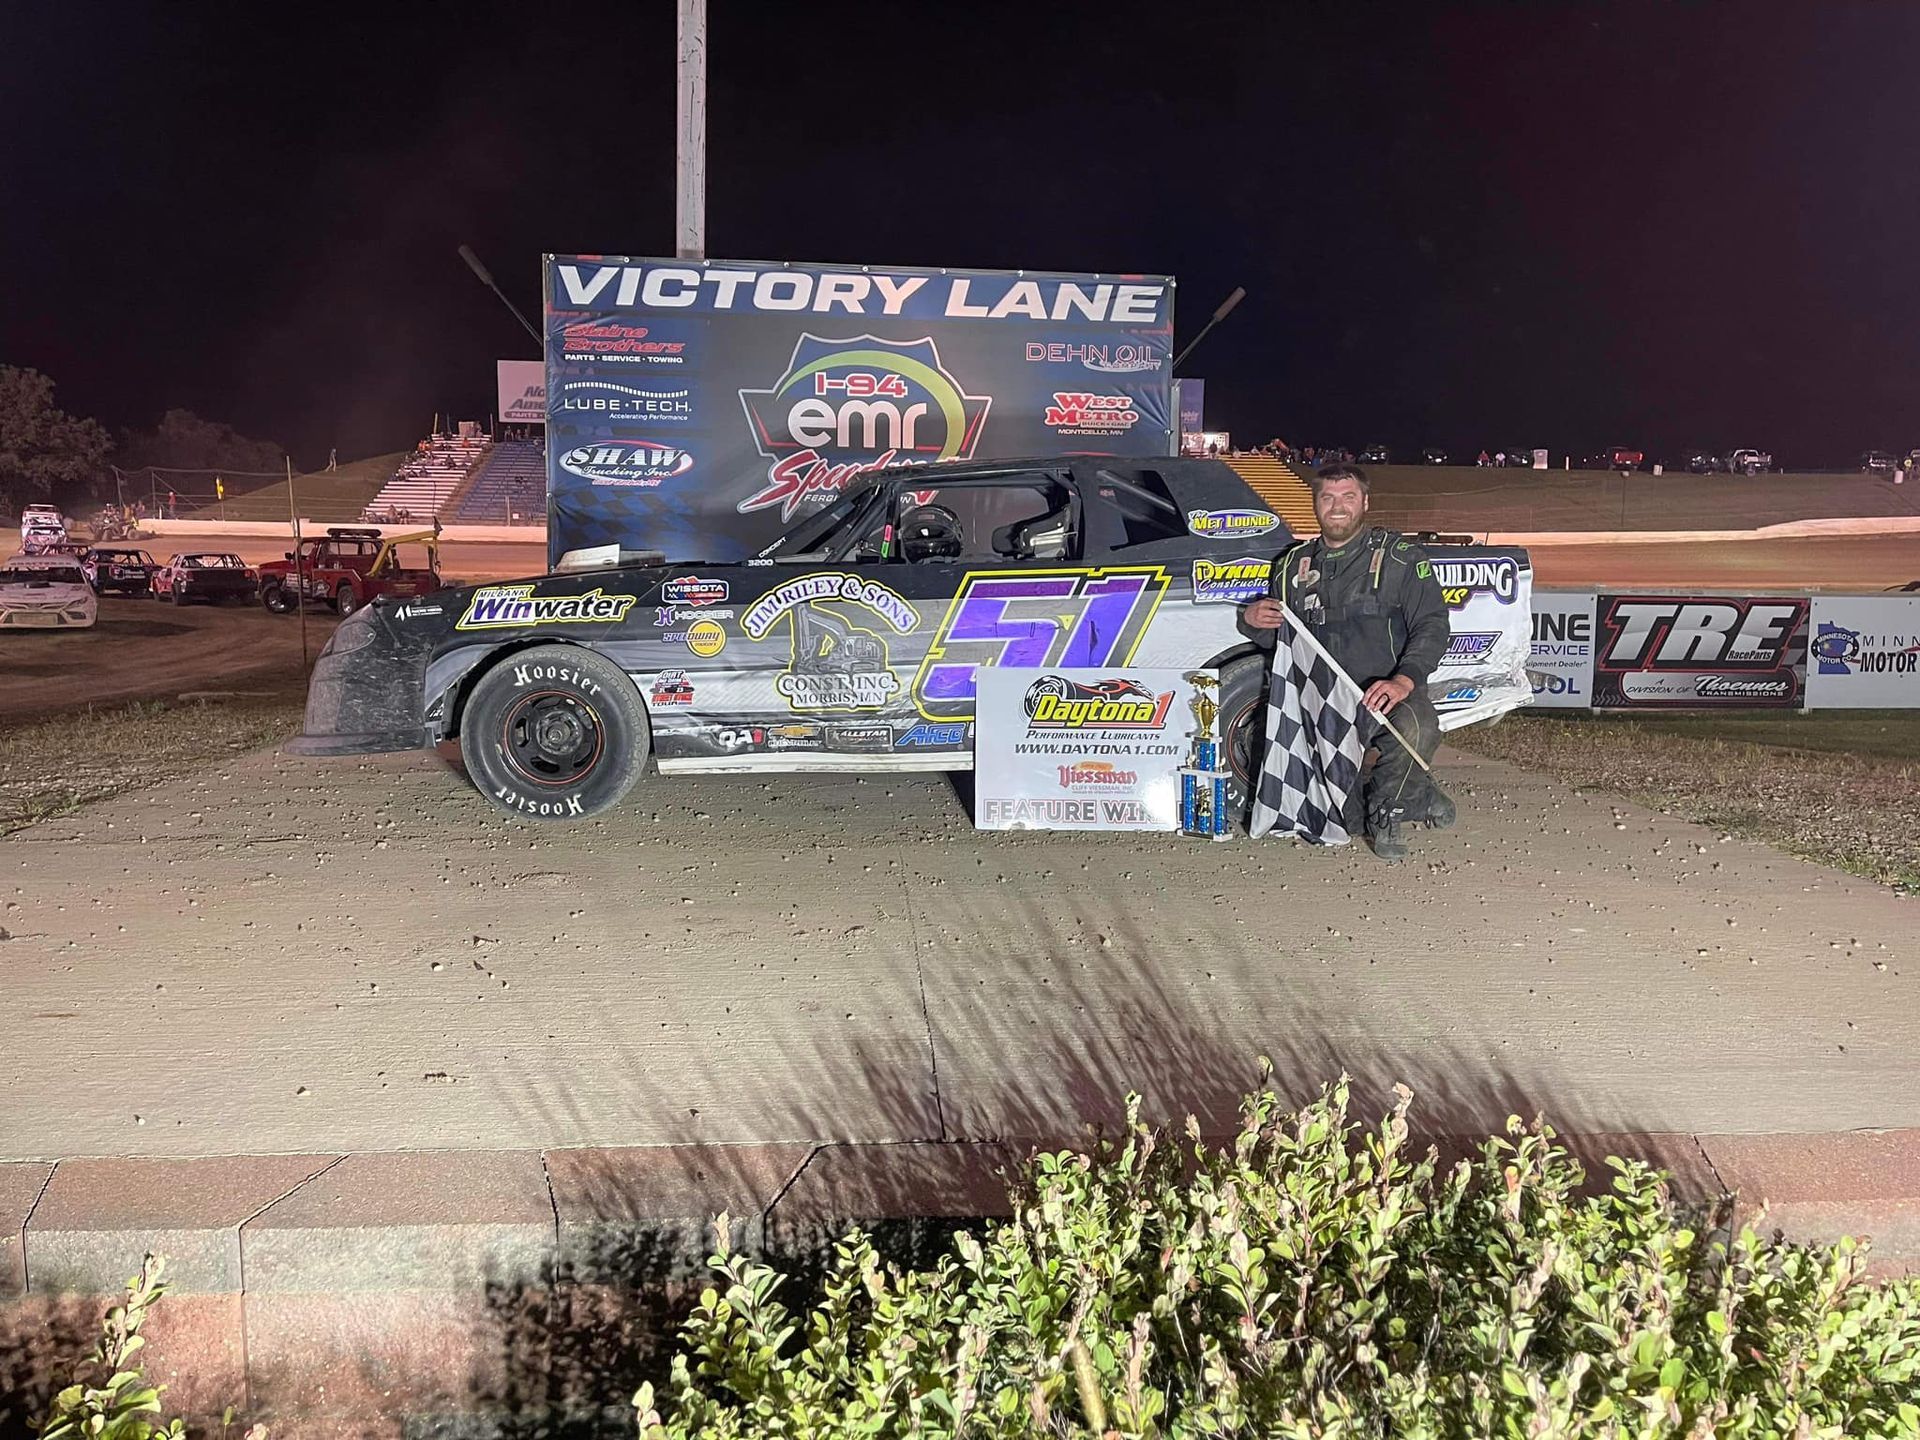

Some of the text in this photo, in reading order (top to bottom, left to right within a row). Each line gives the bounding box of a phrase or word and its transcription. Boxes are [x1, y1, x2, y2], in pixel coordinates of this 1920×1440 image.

[558, 265, 1164, 323] VICTORY LANE
[563, 338, 686, 353] Brothers
[1026, 342, 1162, 363] DEHN OIL
[564, 354, 595, 362] PARTS
[602, 355, 640, 363] SERVICE
[815, 371, 907, 398] I-94
[523, 386, 545, 398] No
[509, 398, 545, 411] Ame
[609, 413, 647, 421] Accelerating
[788, 399, 928, 449] emr
[1058, 428, 1109, 436] MONTICELLO,
[567, 448, 680, 467] SHAW
[582, 466, 673, 479] Trucking Inc.
[758, 536, 787, 559] CONCEPT
[748, 559, 774, 567] 3200
[667, 585, 724, 593] WISSOTA
[1199, 579, 1271, 591] Constructio
[478, 588, 528, 599] MILBANK
[472, 590, 632, 622] Winwater
[749, 578, 912, 632] JIM RILEY & SONS
[675, 610, 734, 620] HOOSIER
[921, 574, 1150, 701] 51
[1608, 604, 1796, 661] TRE
[1817, 632, 1854, 643] MINNESOTA
[1531, 644, 1589, 655] ERVICE
[1817, 653, 1841, 665] MOTOR
[513, 663, 601, 697] Hoosier
[856, 676, 895, 690] INC.
[1695, 674, 1789, 693] Thoennes
[1626, 686, 1692, 694] DIVISION OF
[796, 692, 883, 706] MORRIS, MN
[839, 730, 888, 738] ALLSTAR
[1025, 730, 1161, 741] PERFORMANCE LUBRICANTS
[1057, 765, 1138, 788] Viessman
[495, 786, 585, 817] Hoosier
[984, 799, 1097, 824] FEATURE
